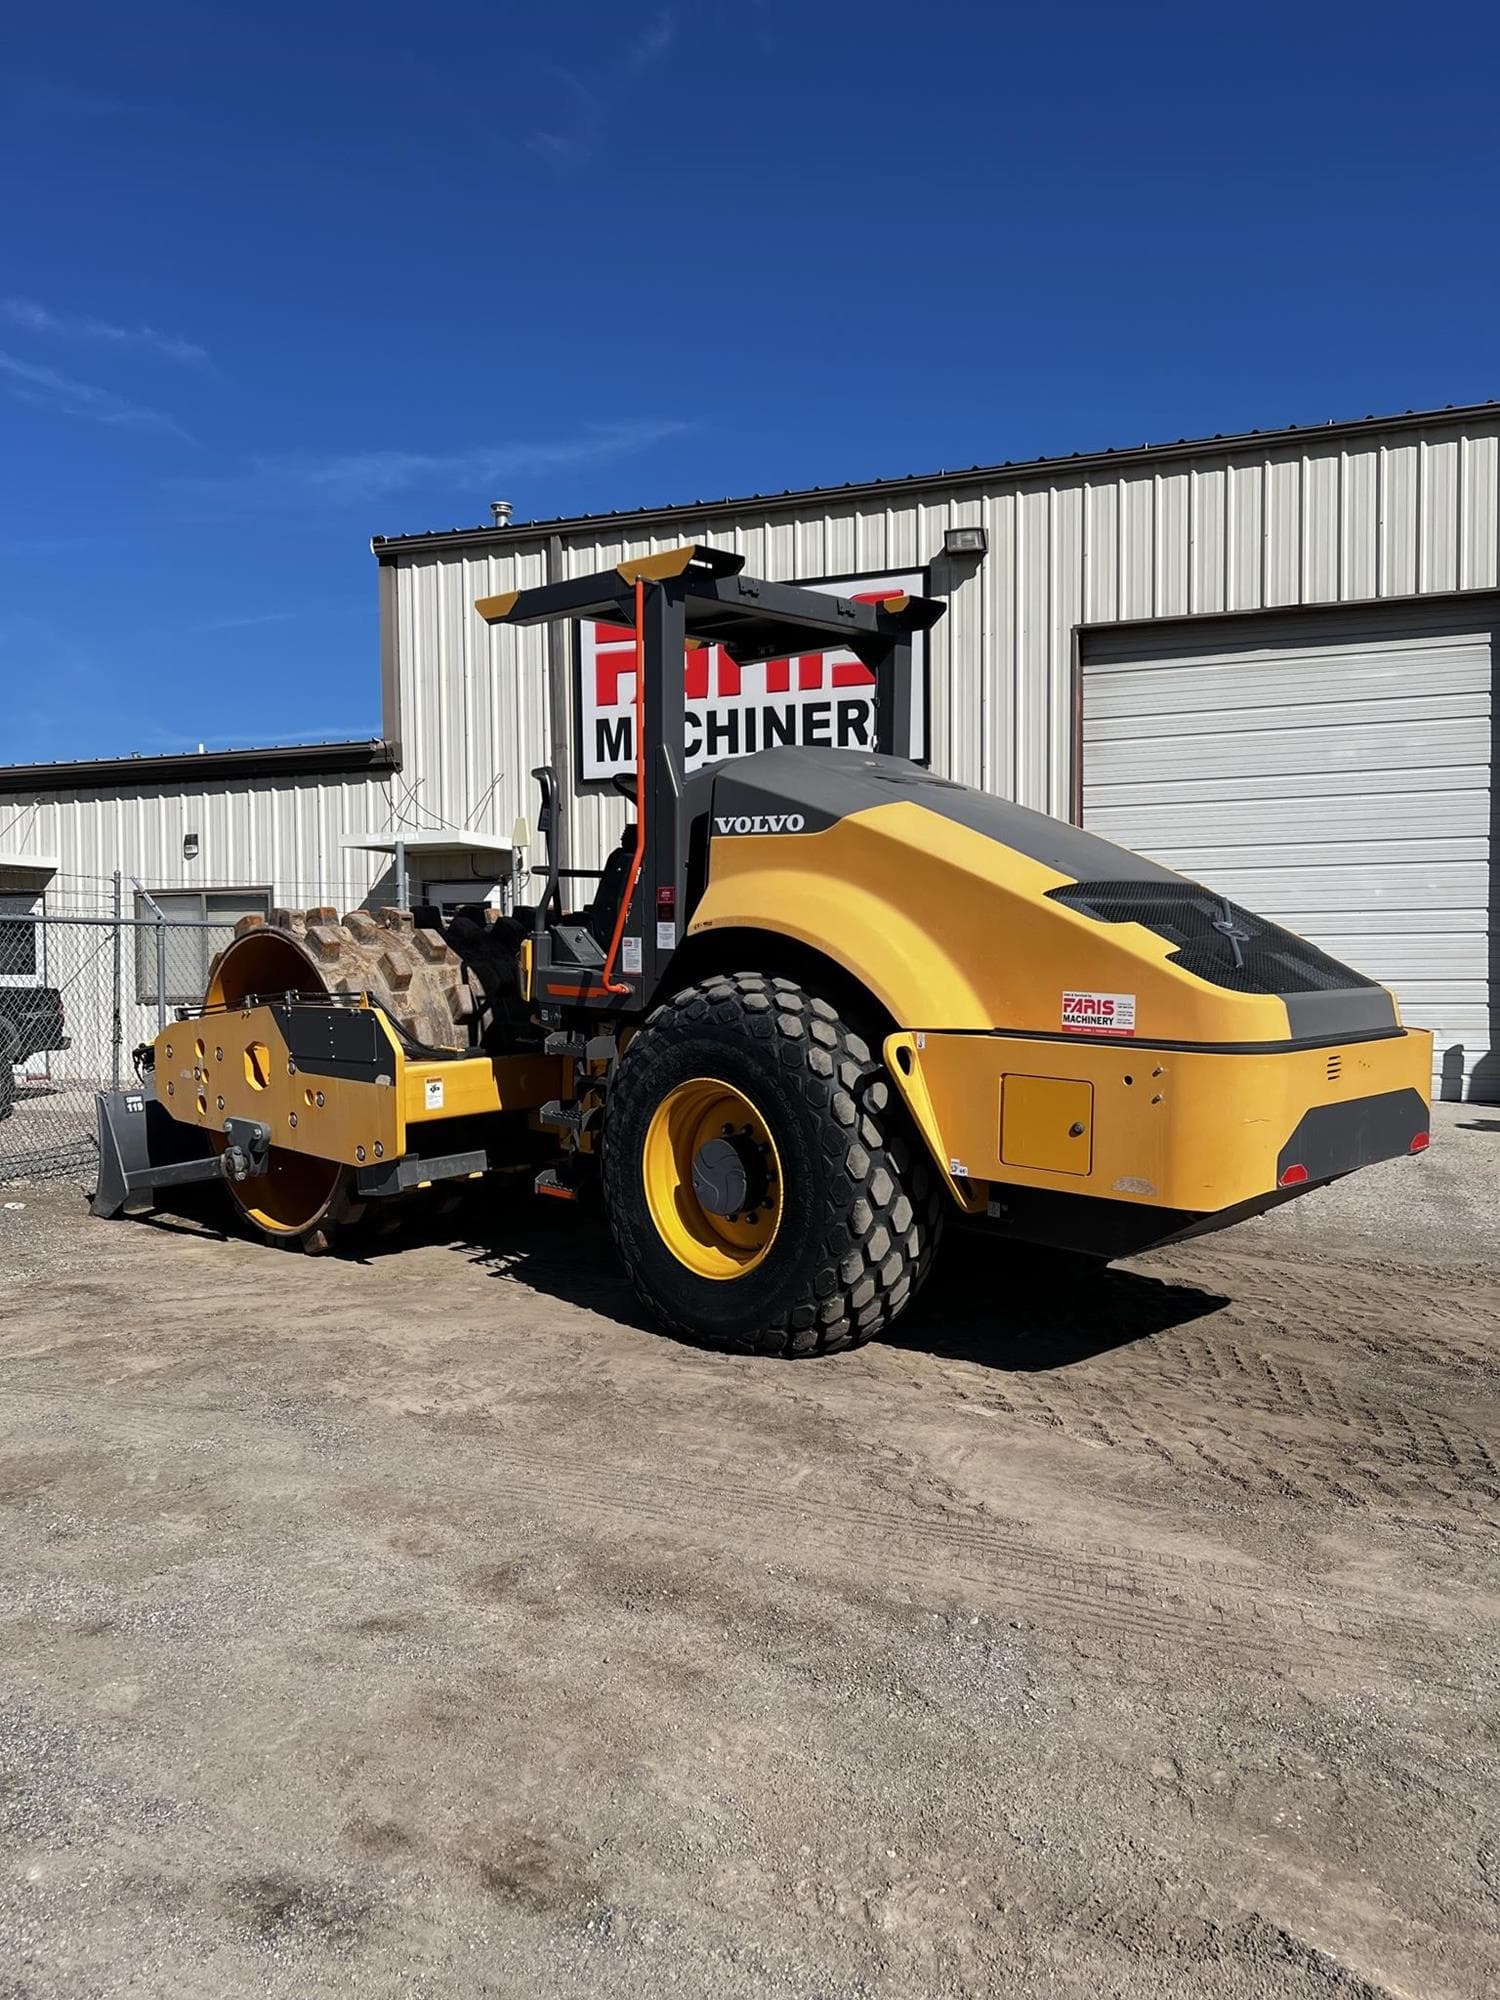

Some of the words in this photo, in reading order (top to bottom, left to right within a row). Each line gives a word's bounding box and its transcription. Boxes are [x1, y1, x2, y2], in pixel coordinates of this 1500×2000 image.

[714, 814, 805, 834] VOLVO
[1063, 998, 1115, 1015] FARIS
[1063, 1014, 1114, 1026] MACHINERY
[127, 1102, 144, 1111] 119
